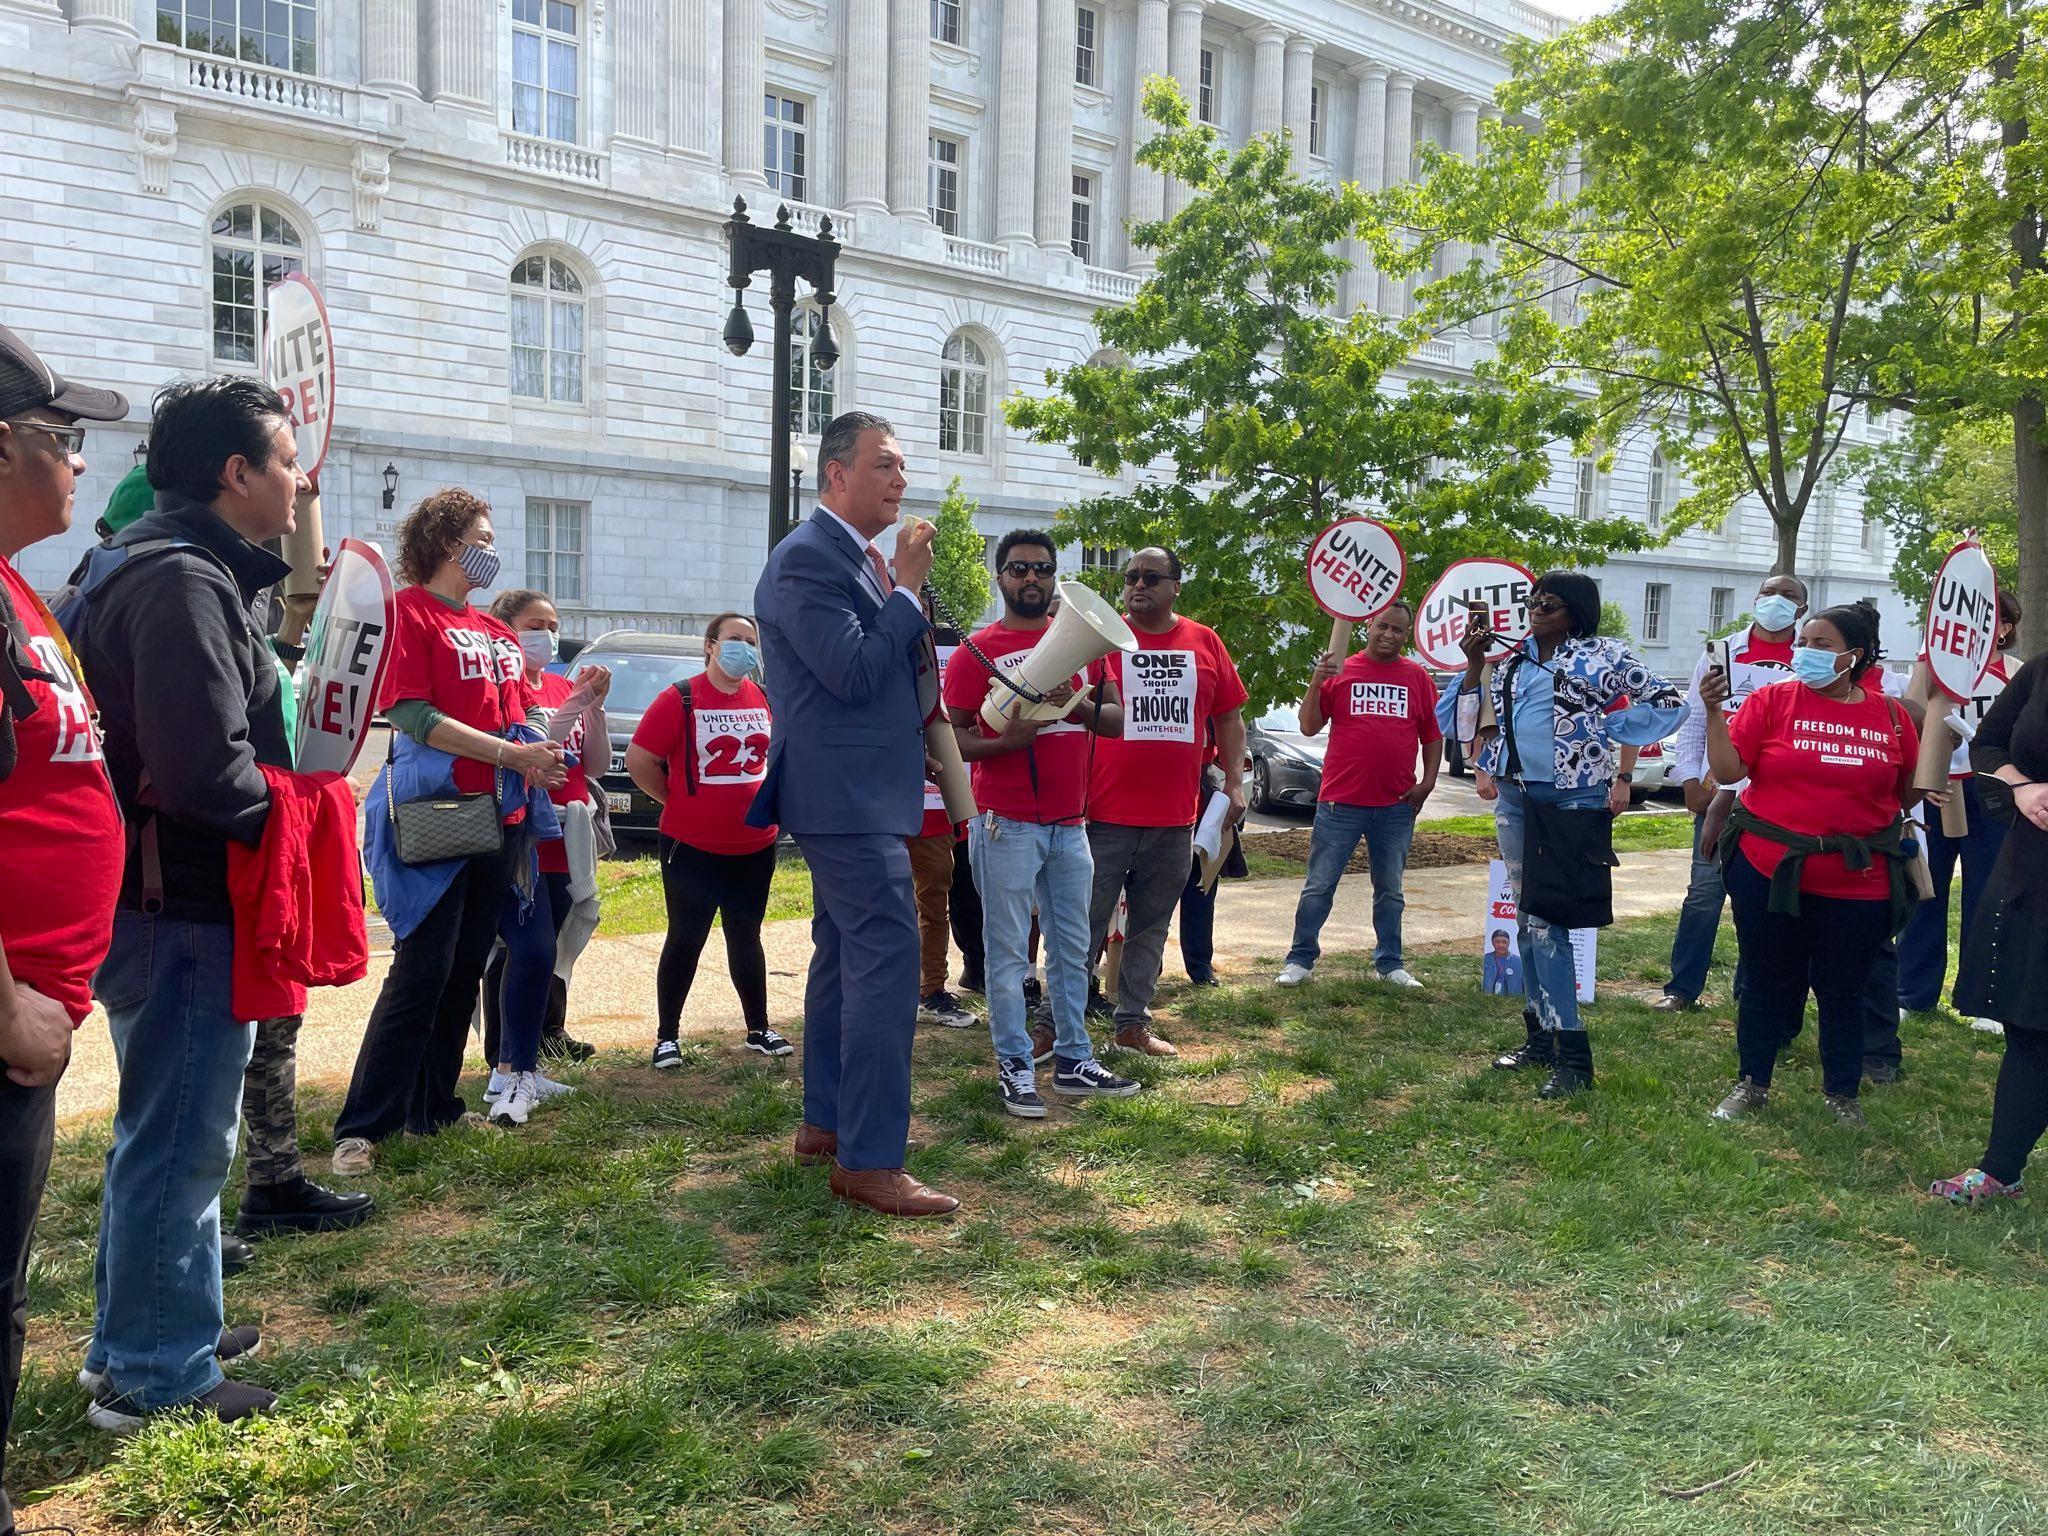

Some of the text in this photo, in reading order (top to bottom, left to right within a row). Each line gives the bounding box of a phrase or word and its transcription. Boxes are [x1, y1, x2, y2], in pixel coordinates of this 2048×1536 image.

[277, 371, 326, 427] RE!
[1330, 529, 1398, 592] UNITE
[1313, 549, 1383, 610] HERE!
[1939, 577, 1994, 634] UNITE
[1427, 607, 1525, 651] HEE!
[1131, 654, 1187, 668] ONE
[1138, 669, 1183, 679] JOB
[1353, 685, 1406, 700] UNITE
[702, 713, 764, 722] UNITEHERE!
[1132, 696, 1188, 724] ENOUGH
[1353, 700, 1405, 716] HERE!
[709, 722, 765, 733] LOCAL
[1137, 725, 1185, 733] UNITEHERE!
[1794, 720, 1855, 737] FREEDOM
[1861, 728, 1889, 744] RIDE
[705, 732, 770, 777] 23
[1793, 739, 1839, 753] VOTING
[1845, 744, 1888, 763] RIGHTS
